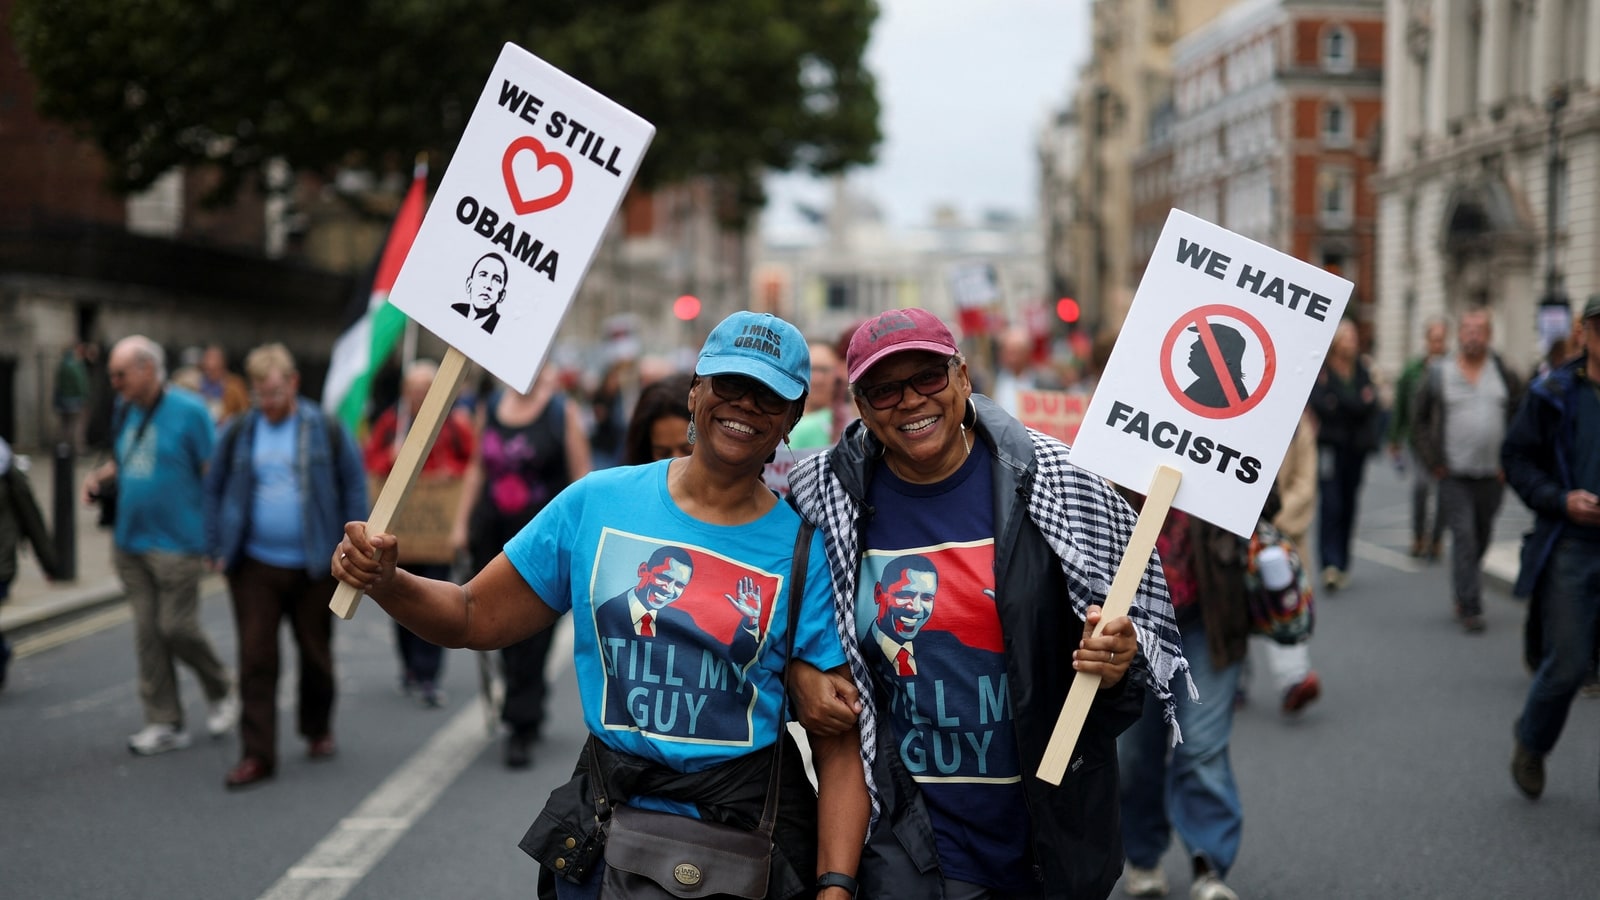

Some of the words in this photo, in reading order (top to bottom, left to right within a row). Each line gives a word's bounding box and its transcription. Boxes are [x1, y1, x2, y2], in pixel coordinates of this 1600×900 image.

[498, 79, 544, 125] WE
[545, 110, 622, 177] STILL
[456, 196, 559, 282] OBAMA
[1176, 237, 1232, 280] WE
[1236, 264, 1332, 322] HATE
[734, 336, 781, 359] OBAMA
[742, 325, 749, 335] I
[749, 324, 782, 346] MISS
[1105, 400, 1262, 484] FACISTS
[601, 635, 683, 687] STILL
[699, 649, 747, 694] MY
[627, 686, 708, 735] GUY
[900, 727, 994, 774] GUY
